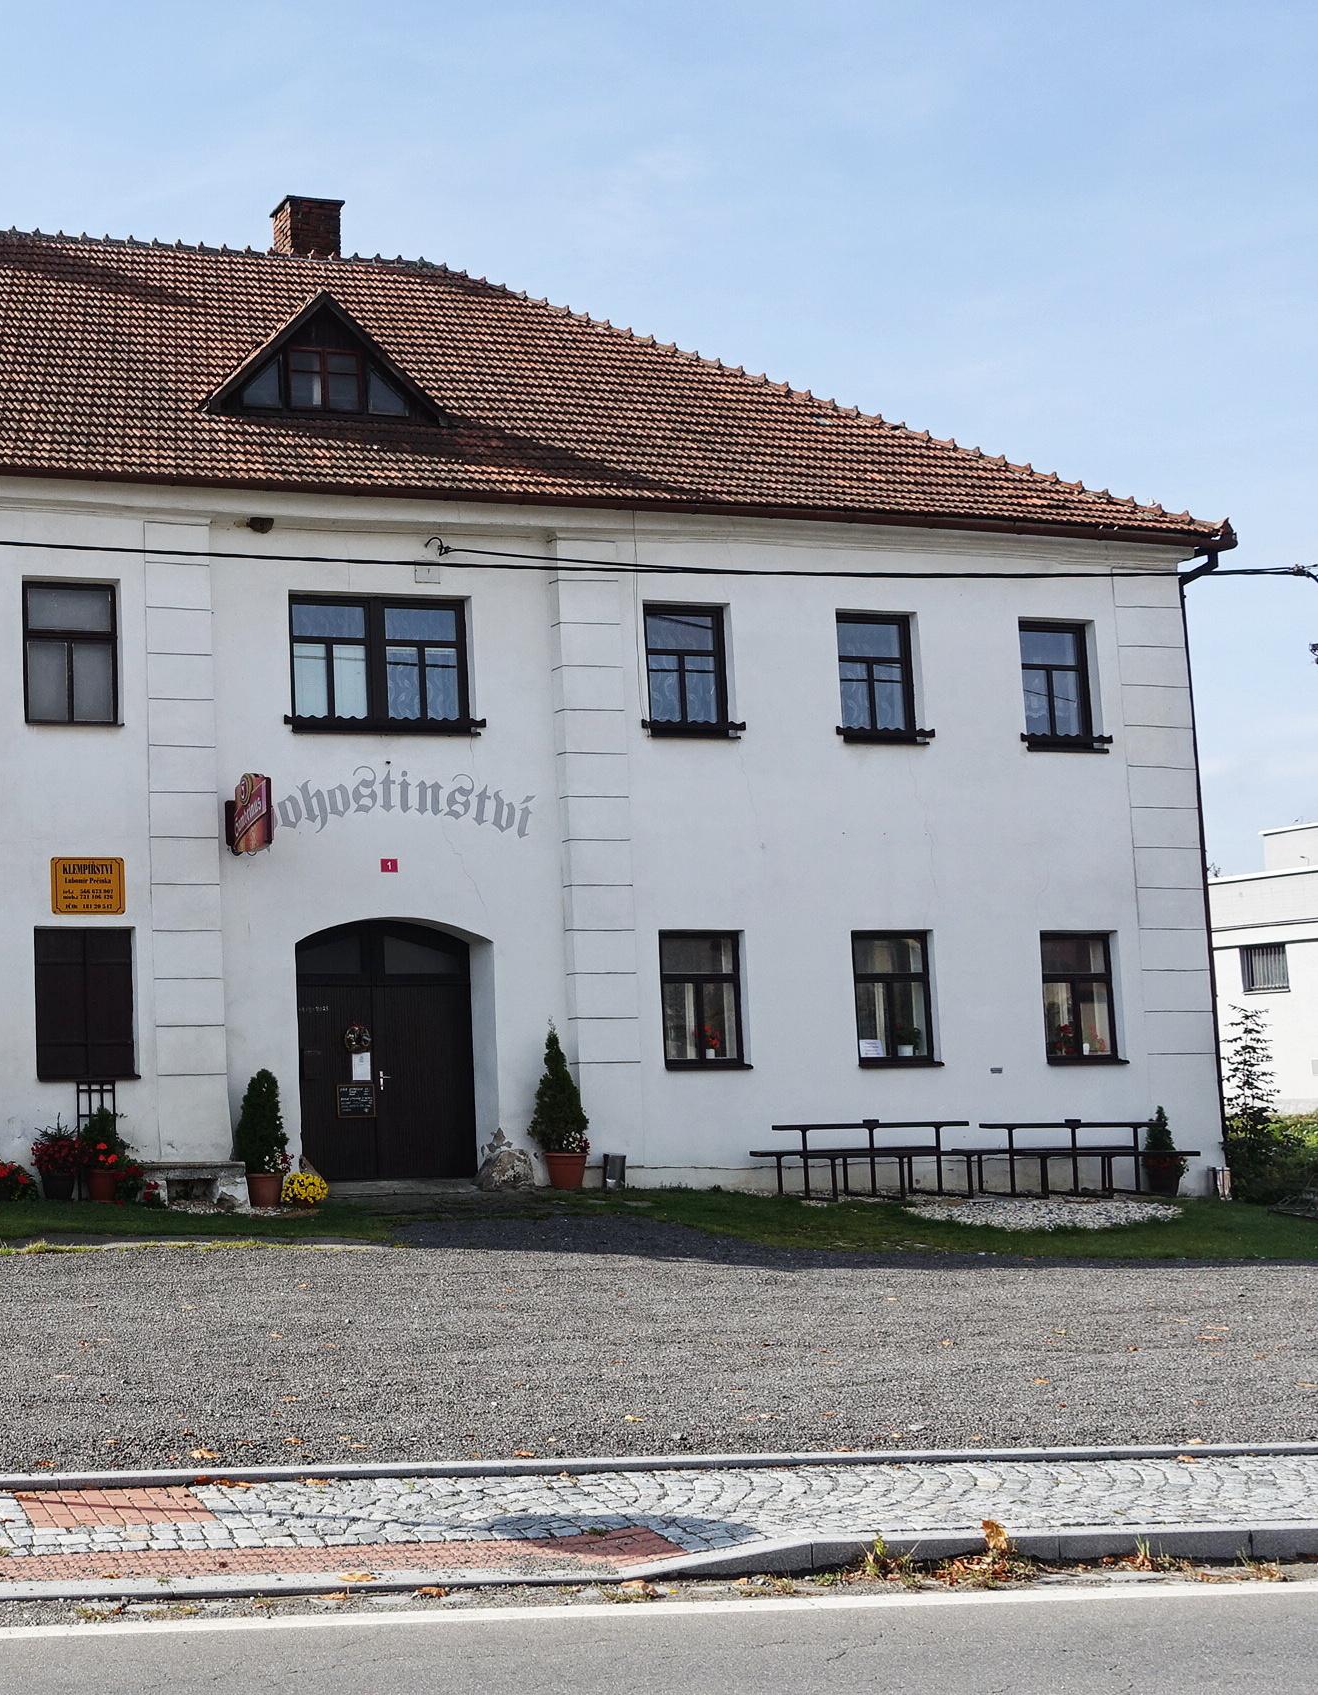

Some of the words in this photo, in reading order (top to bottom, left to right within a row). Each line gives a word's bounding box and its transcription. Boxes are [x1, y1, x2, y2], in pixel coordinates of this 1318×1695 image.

[273, 765, 537, 839] ohostinství
[62, 861, 113, 874] KLEMPÍŘSTVÍ
[386, 861, 393, 871] 1
